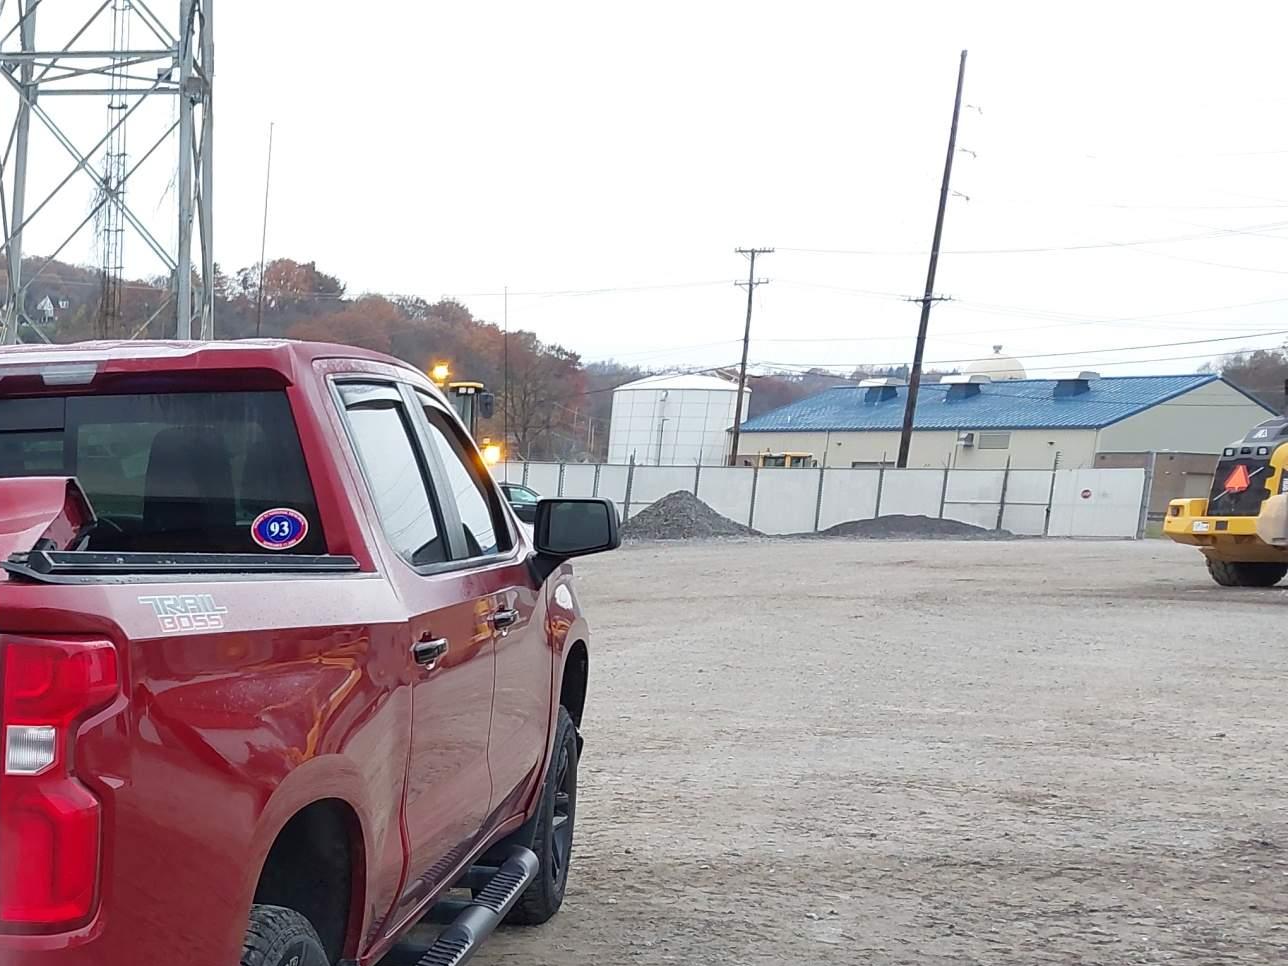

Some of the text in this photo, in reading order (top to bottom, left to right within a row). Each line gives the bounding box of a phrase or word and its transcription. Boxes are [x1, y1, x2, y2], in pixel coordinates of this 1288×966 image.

[269, 520, 290, 537] 93
[137, 593, 229, 615] TRAIL
[157, 613, 225, 633] BOSS
